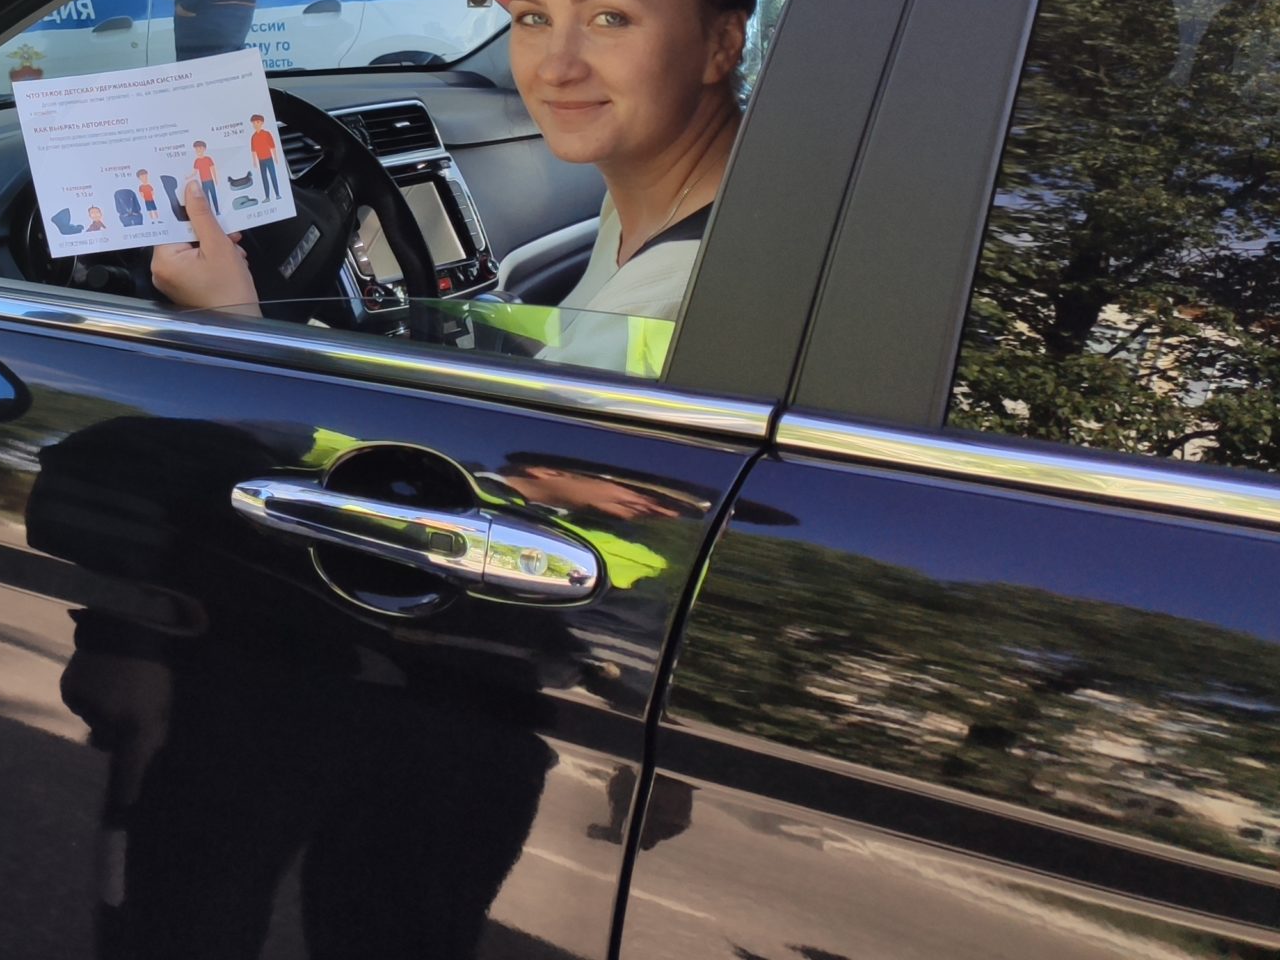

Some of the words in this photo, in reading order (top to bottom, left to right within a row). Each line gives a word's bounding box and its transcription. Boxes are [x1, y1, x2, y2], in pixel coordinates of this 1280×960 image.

[251, 22, 286, 32] ссии
[41, 90, 62, 98] ТАКОЕ
[64, 86, 94, 96] ДЕТСКАЯ
[96, 79, 155, 92] УДЕРЖИВАЮЩАЯ
[156, 73, 192, 84] СИСТЕМА?
[49, 123, 80, 132] ВЫБРАТЬ
[82, 118, 129, 128] АВТОКРЕСЛО?
